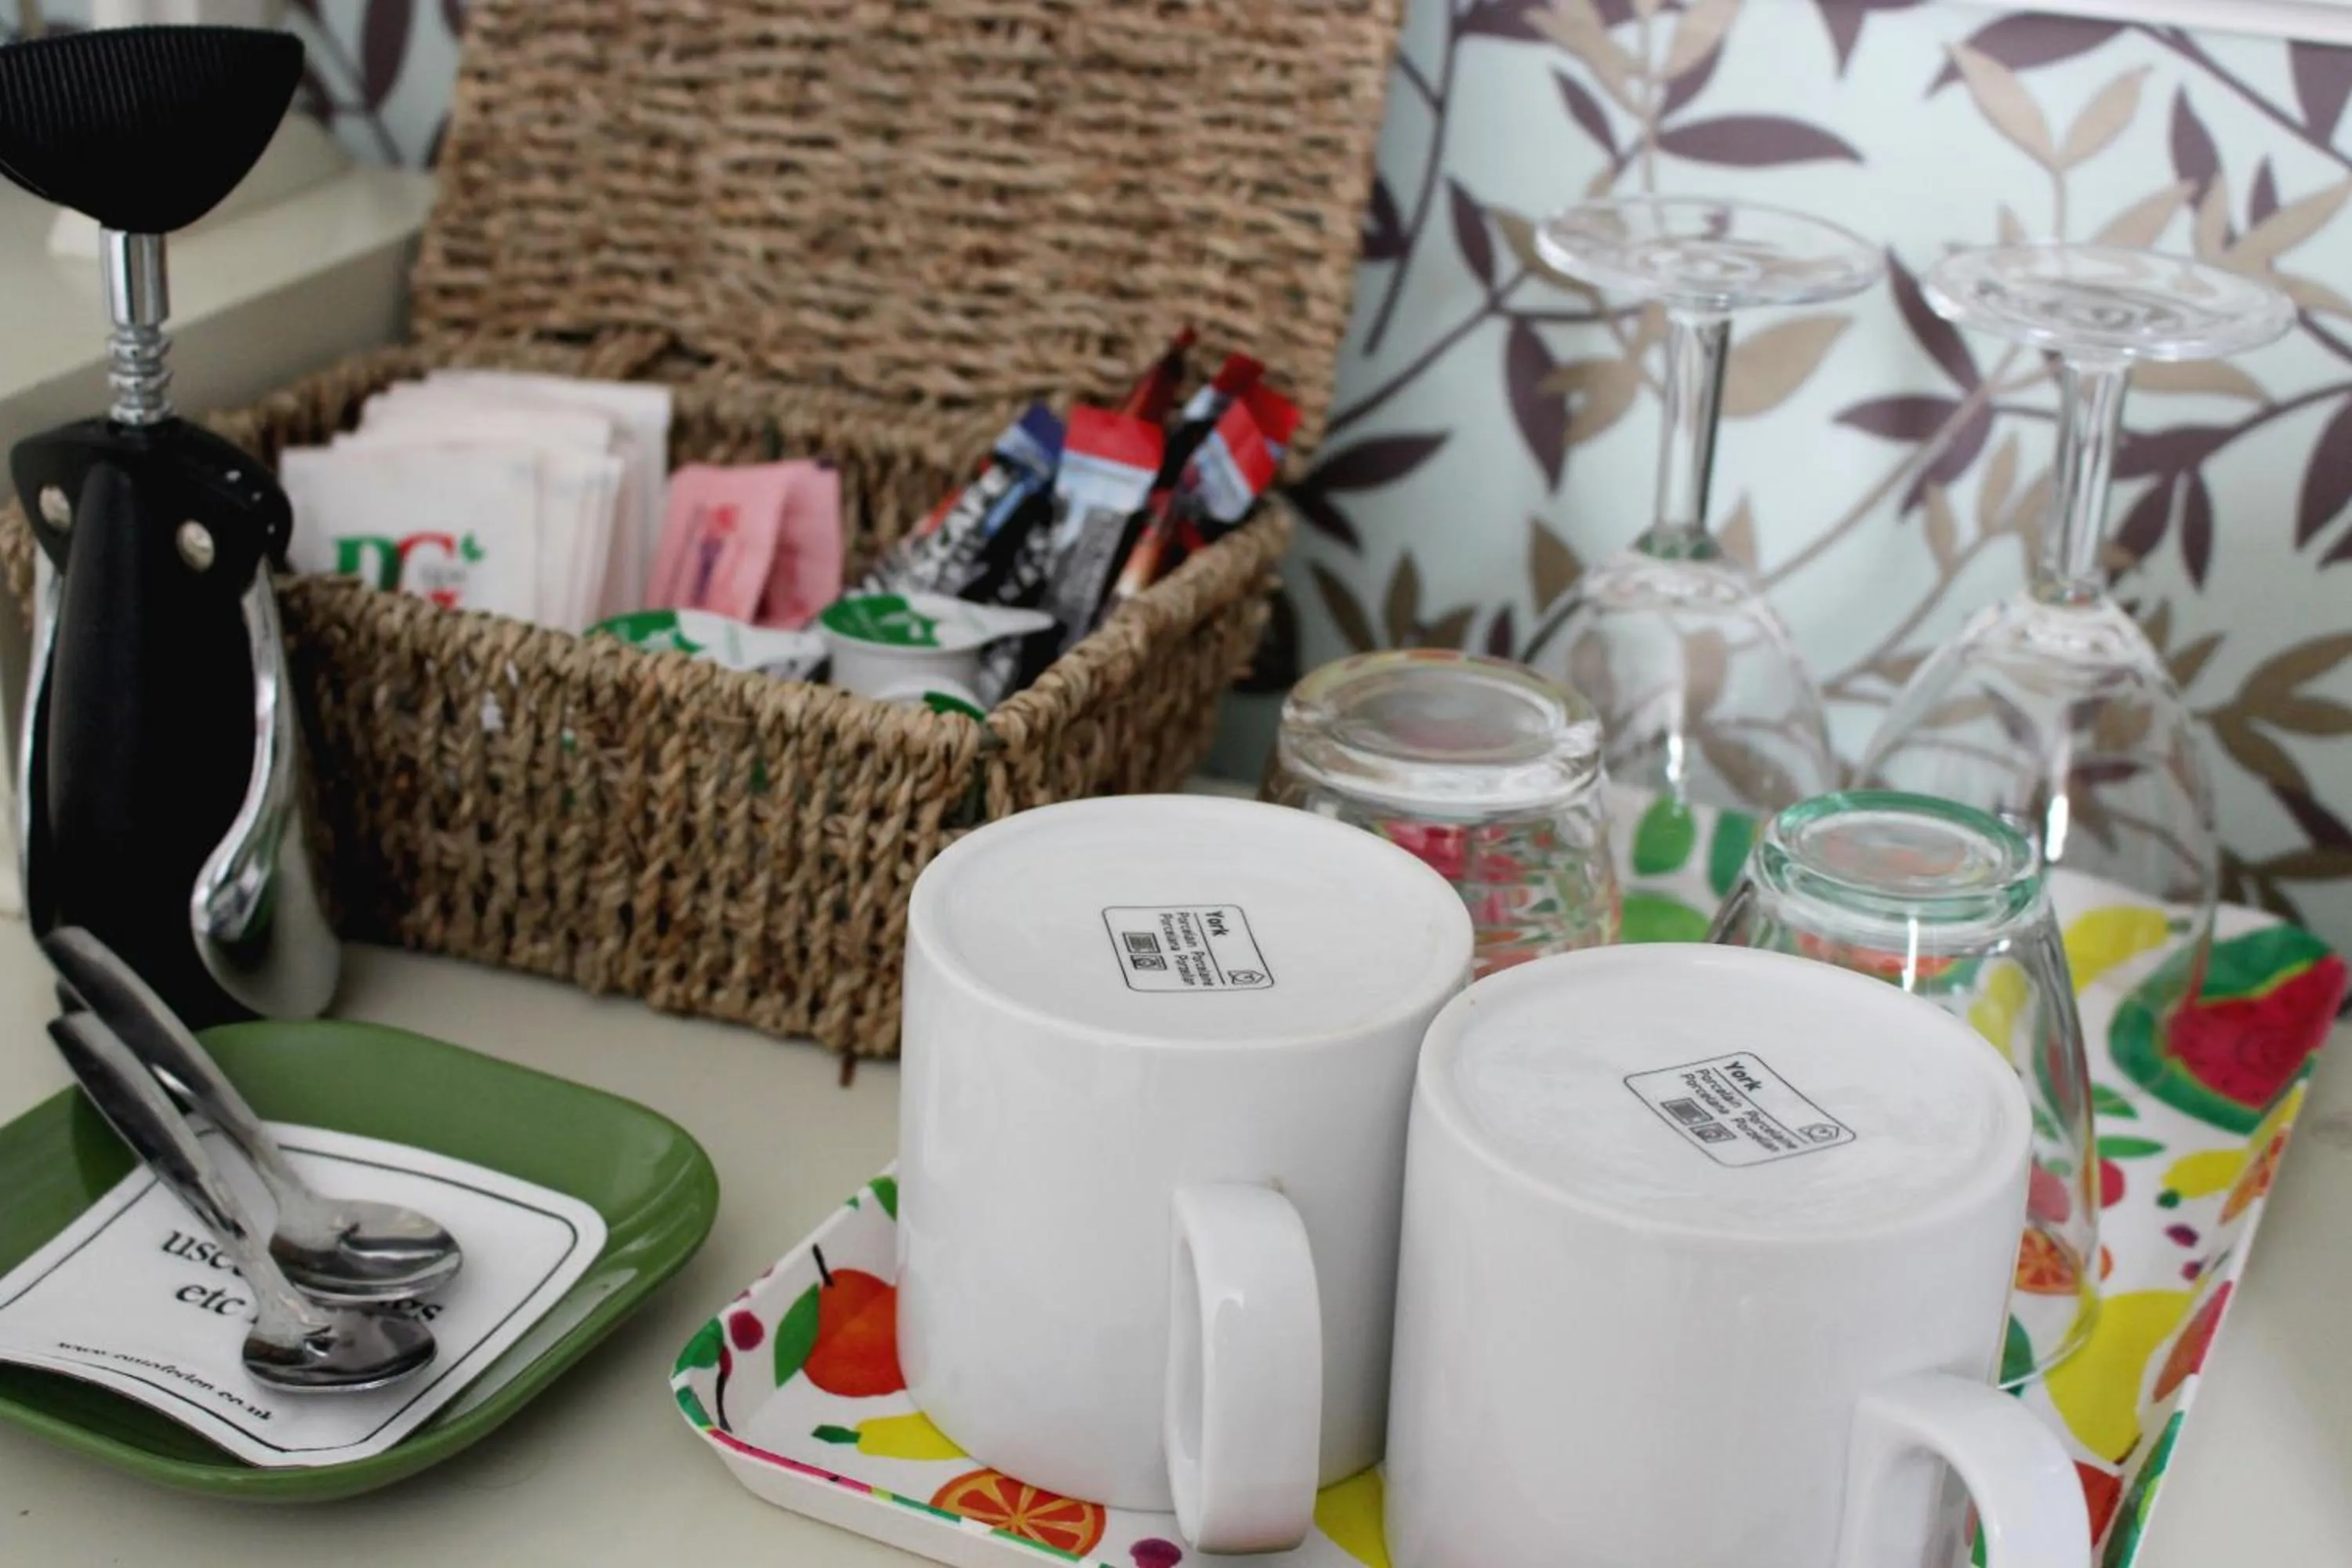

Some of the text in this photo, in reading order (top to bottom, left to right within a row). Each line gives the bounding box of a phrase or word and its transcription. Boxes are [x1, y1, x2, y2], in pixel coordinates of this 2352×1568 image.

[1205, 910, 1230, 937] York
[1696, 1068, 1744, 1109] Porcelain
[1723, 1061, 1762, 1092] York
